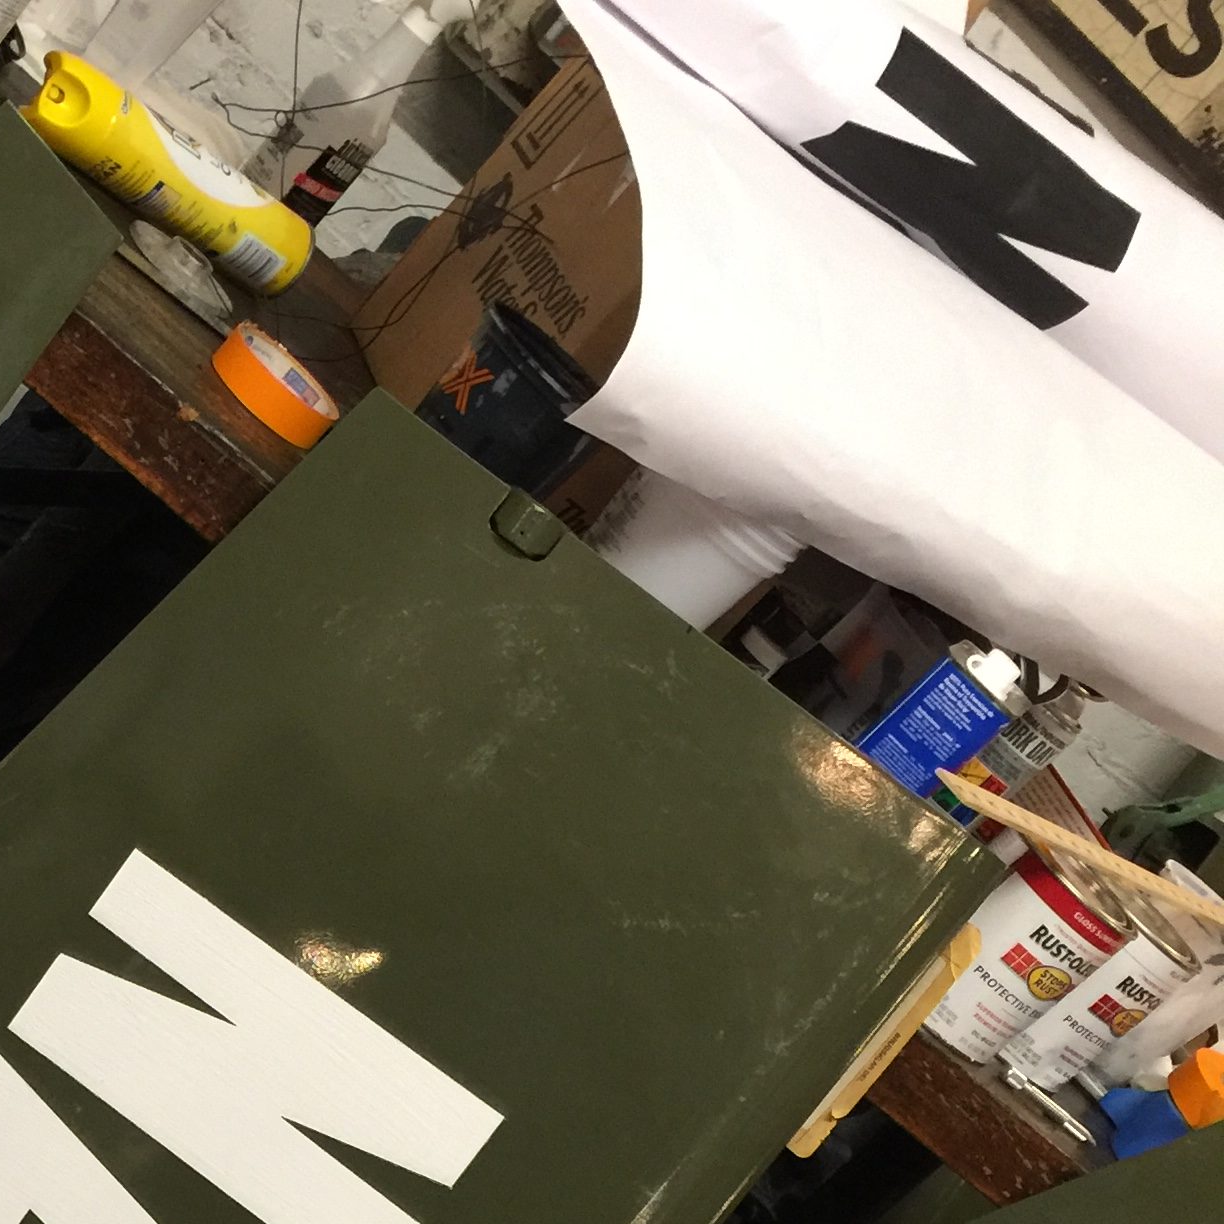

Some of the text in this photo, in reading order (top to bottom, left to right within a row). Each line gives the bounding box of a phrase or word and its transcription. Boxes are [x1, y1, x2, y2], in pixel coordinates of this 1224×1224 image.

[800, 26, 1142, 331] N
[1073, 911, 1098, 933] GLOSS
[1029, 923, 1099, 977] RUST-OLE
[973, 965, 1031, 1015] PROTECTIVE
[1034, 978, 1060, 996] RUST
